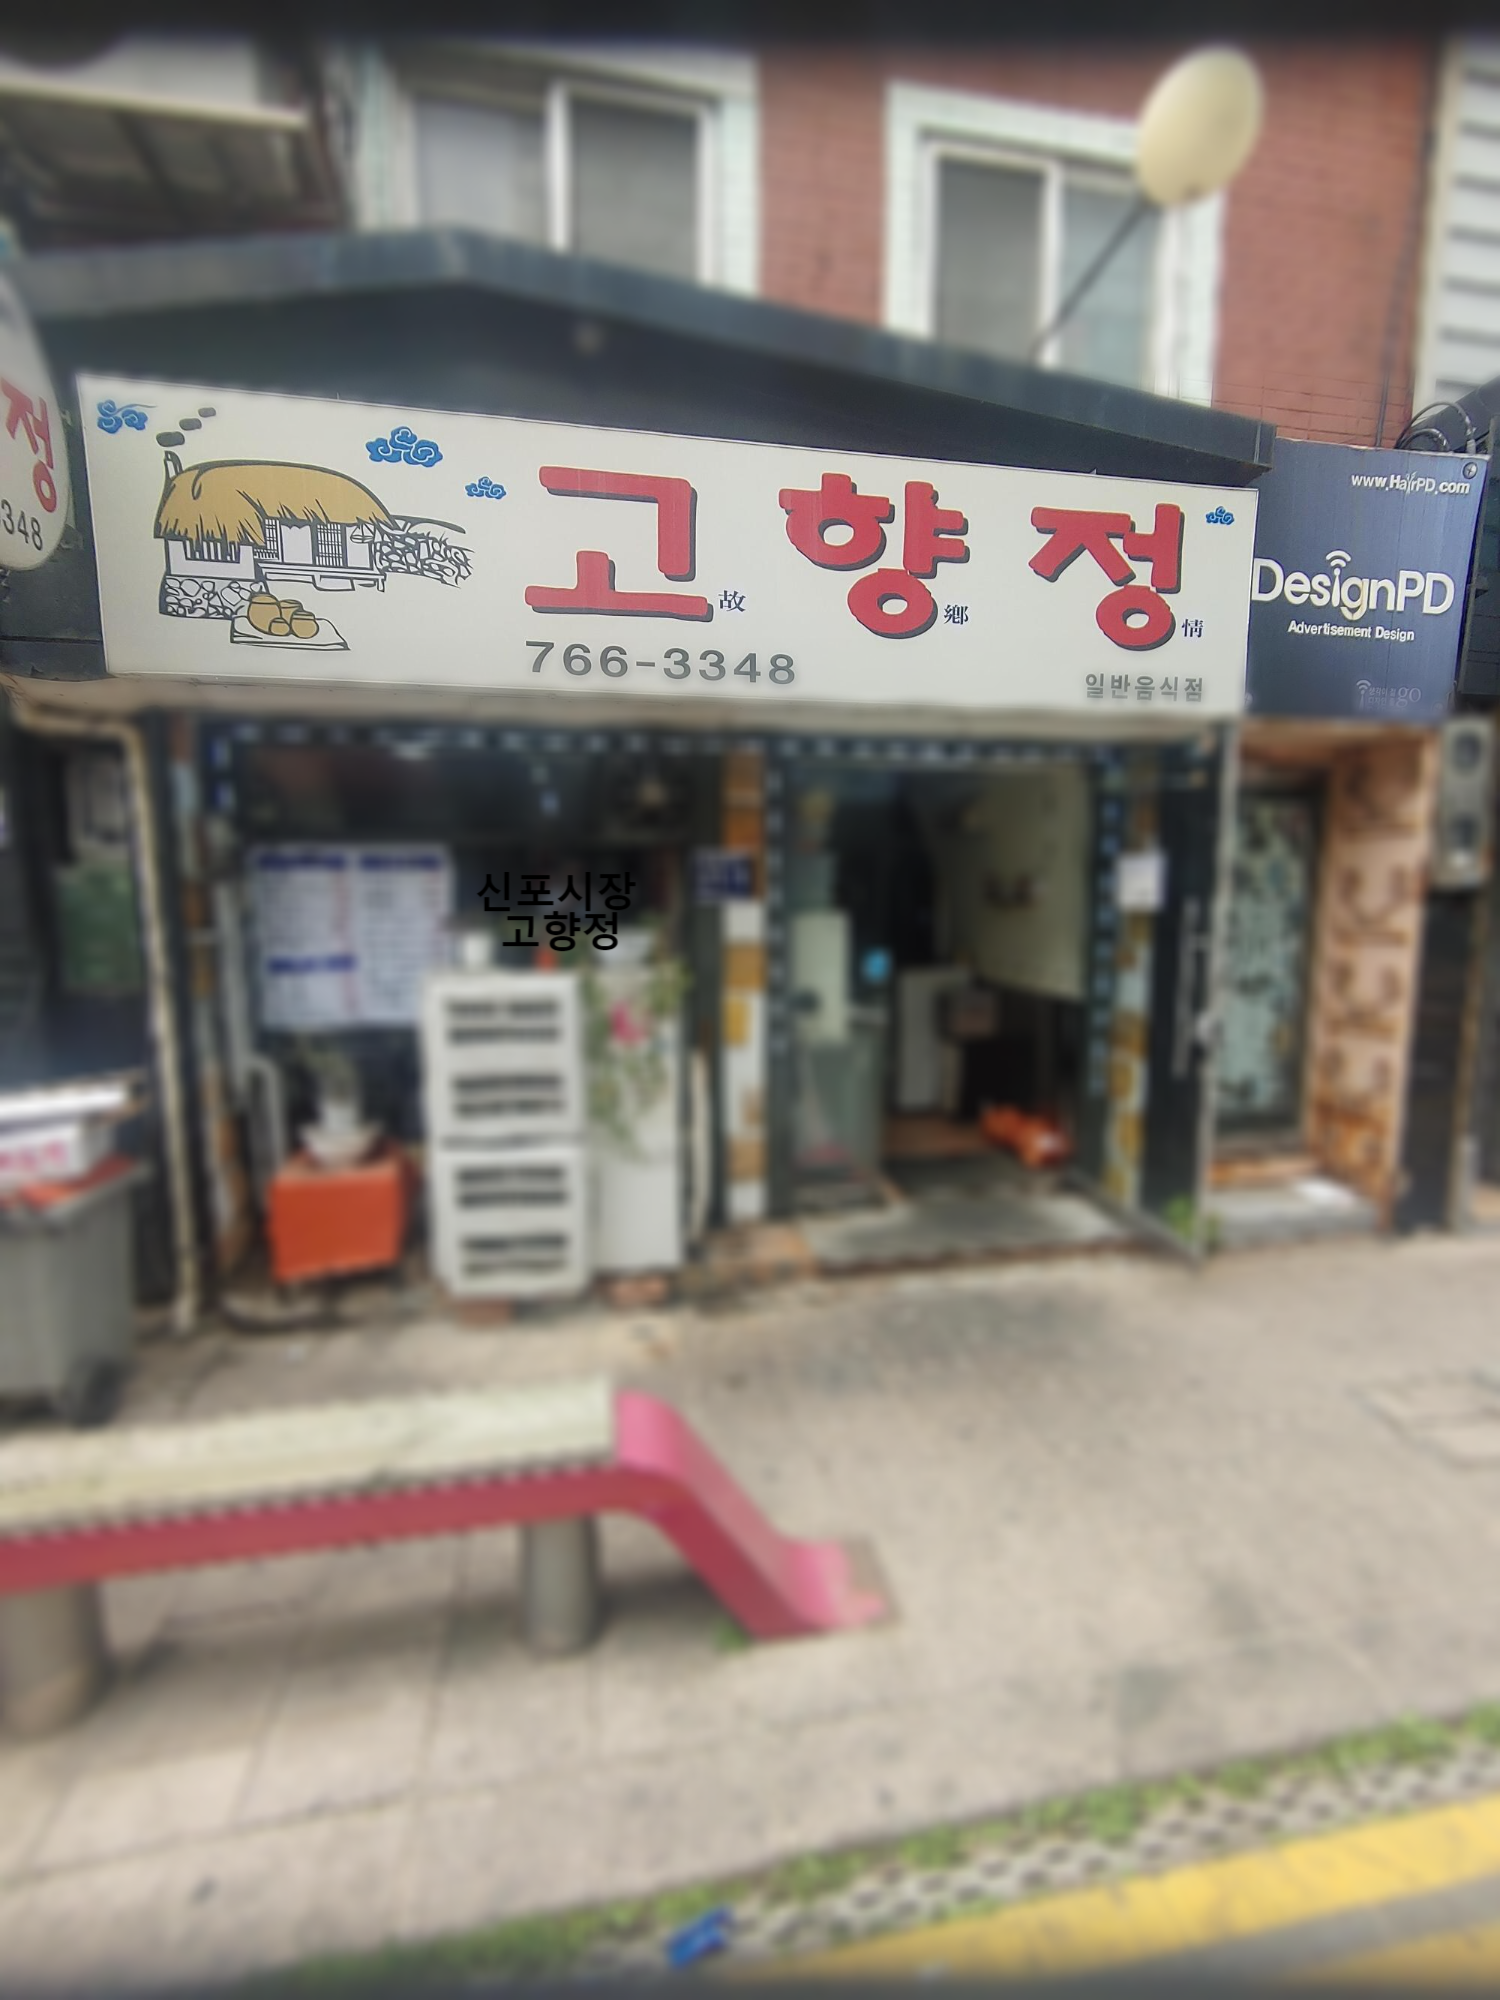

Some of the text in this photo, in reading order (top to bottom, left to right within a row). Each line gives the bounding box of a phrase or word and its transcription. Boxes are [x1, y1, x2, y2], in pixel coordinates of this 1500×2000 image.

[1351, 472, 1471, 495] www.HairPD.com
[524, 465, 1186, 652] 고향정
[1251, 557, 1455, 621] DesignPD
[718, 589, 747, 613] 故
[1181, 618, 1204, 638] 情
[1287, 620, 1415, 642] Advertisement Design
[525, 640, 796, 685] 766-3348
[1085, 672, 1204, 703] 일반음식점
